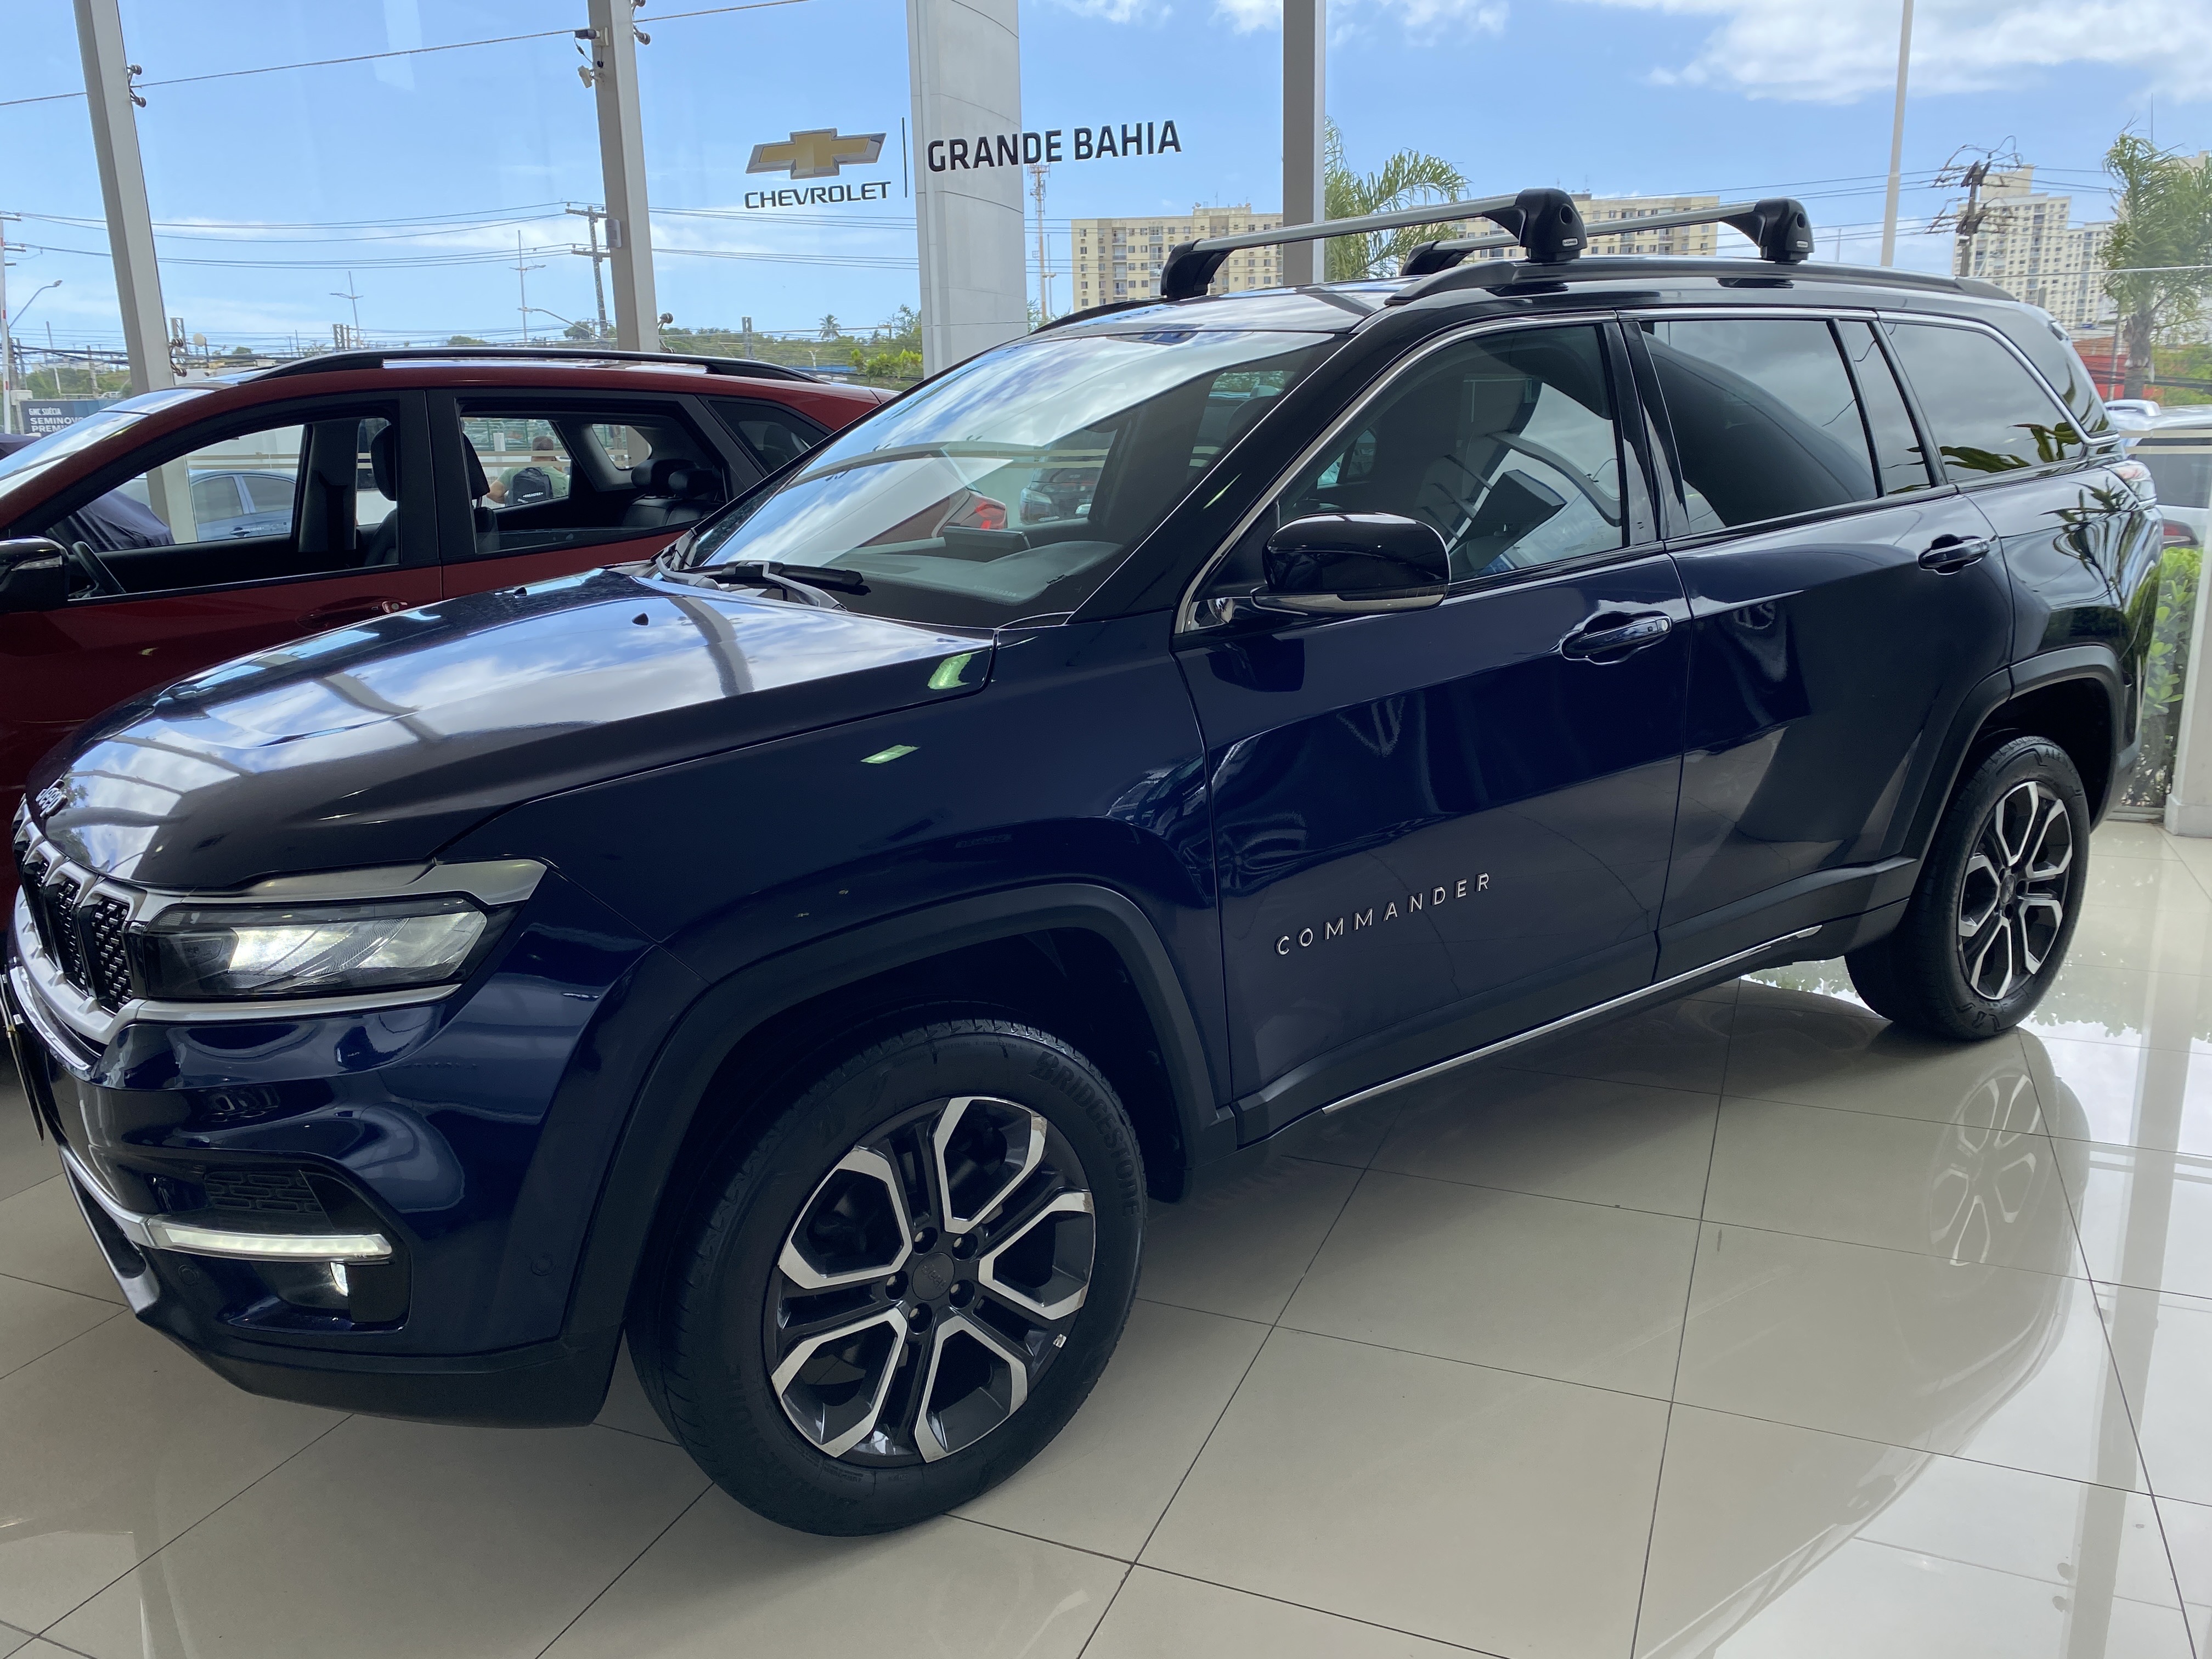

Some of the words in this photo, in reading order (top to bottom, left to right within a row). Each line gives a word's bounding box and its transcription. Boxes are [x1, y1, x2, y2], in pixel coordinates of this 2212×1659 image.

[927, 129, 1063, 173] GRANDE
[1074, 120, 1182, 160] BAHIA
[744, 180, 891, 209] CHEVROLET
[35, 778, 68, 818] Jeep
[1275, 872, 1490, 955] COMMANDER
[1028, 1051, 1139, 1217] BRIDGESTONE
